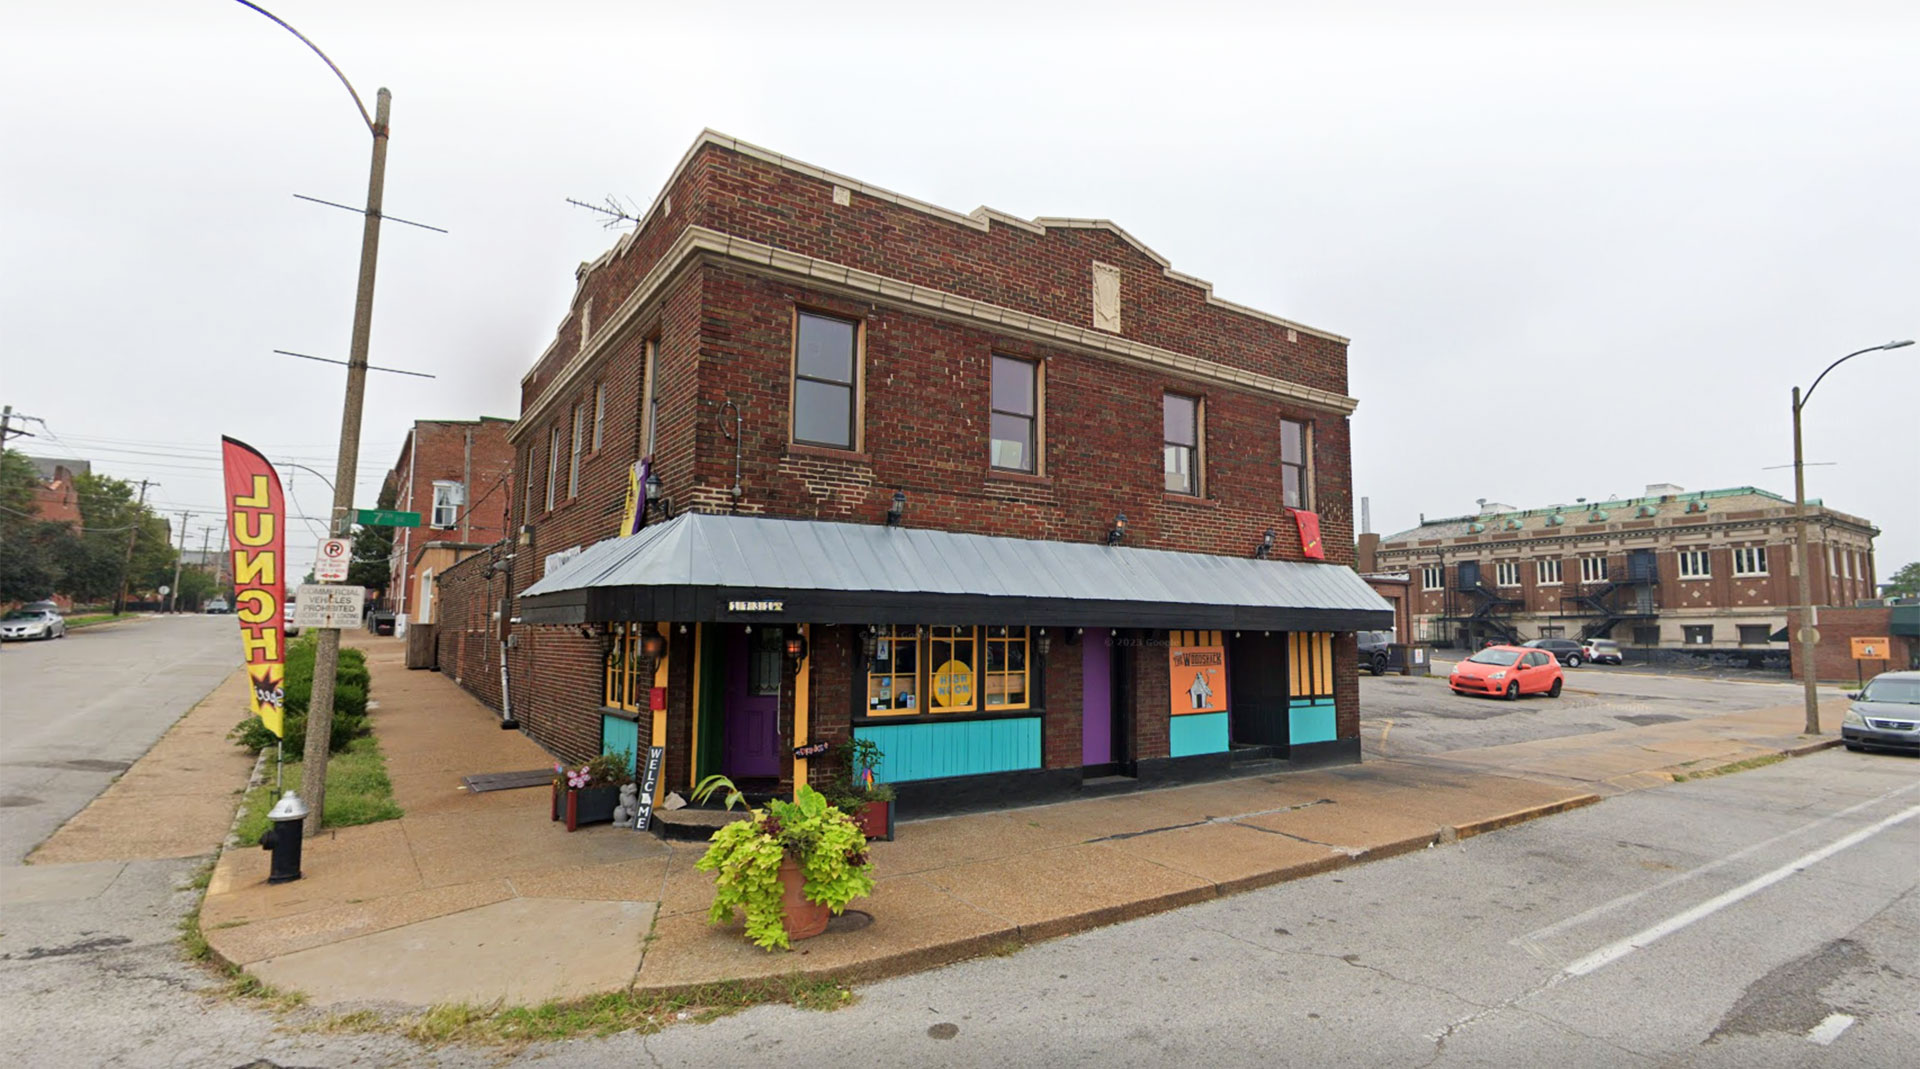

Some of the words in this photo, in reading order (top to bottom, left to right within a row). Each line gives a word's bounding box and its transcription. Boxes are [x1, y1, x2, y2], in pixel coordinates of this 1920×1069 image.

[301, 588, 360, 596] COMMERCIAL
[309, 596, 352, 604] VEHICLES
[303, 604, 356, 612] PROHIBITED
